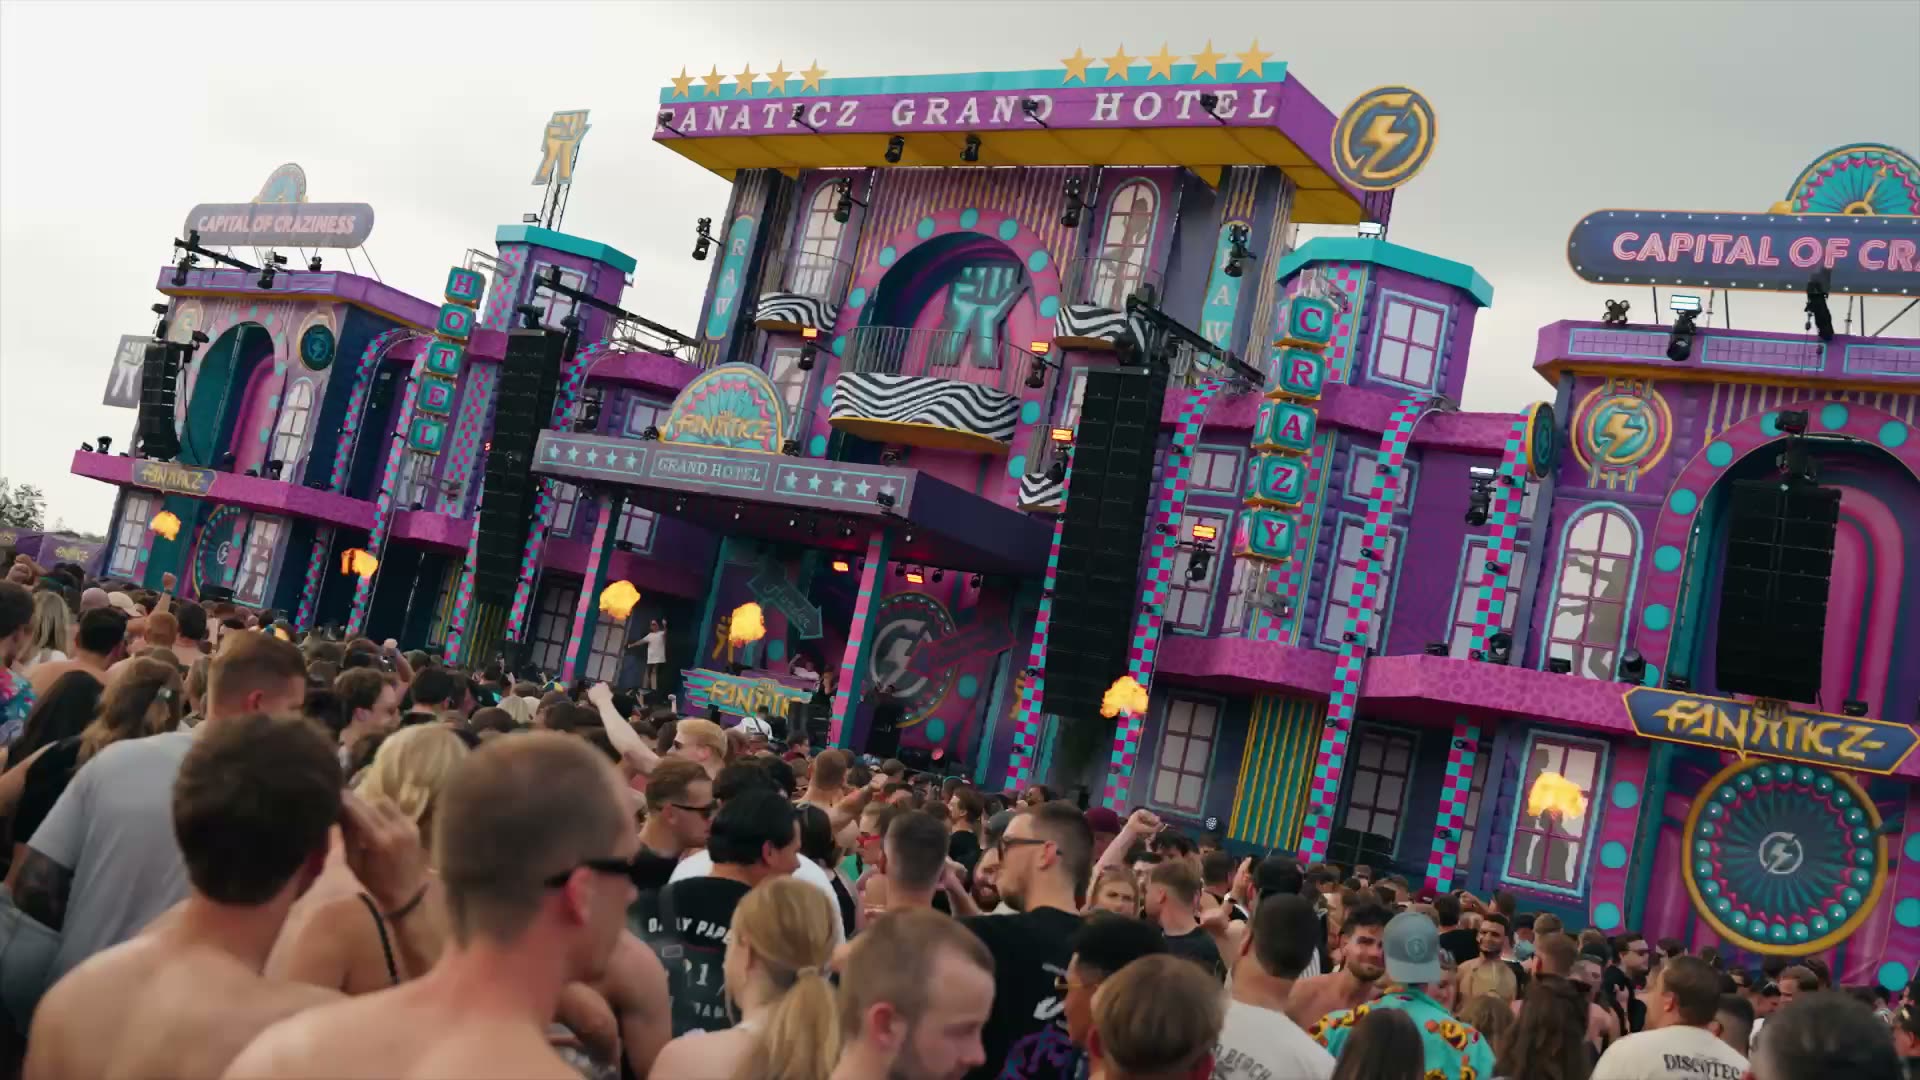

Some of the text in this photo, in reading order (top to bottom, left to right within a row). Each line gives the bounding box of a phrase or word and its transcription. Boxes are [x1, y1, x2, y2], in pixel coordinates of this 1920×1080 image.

[891, 94, 1053, 127] GRAND
[1090, 88, 1275, 121] HOTEL
[197, 215, 357, 235] CAPITAL OF CRAZINESS
[1612, 231, 1780, 267] CAPITAL
[1788, 236, 1851, 270] OF
[715, 238, 747, 317] RAW
[419, 272, 474, 445] HOTEL
[1263, 307, 1323, 548] CRAZY
[657, 457, 761, 482] GRAND HOTEL
